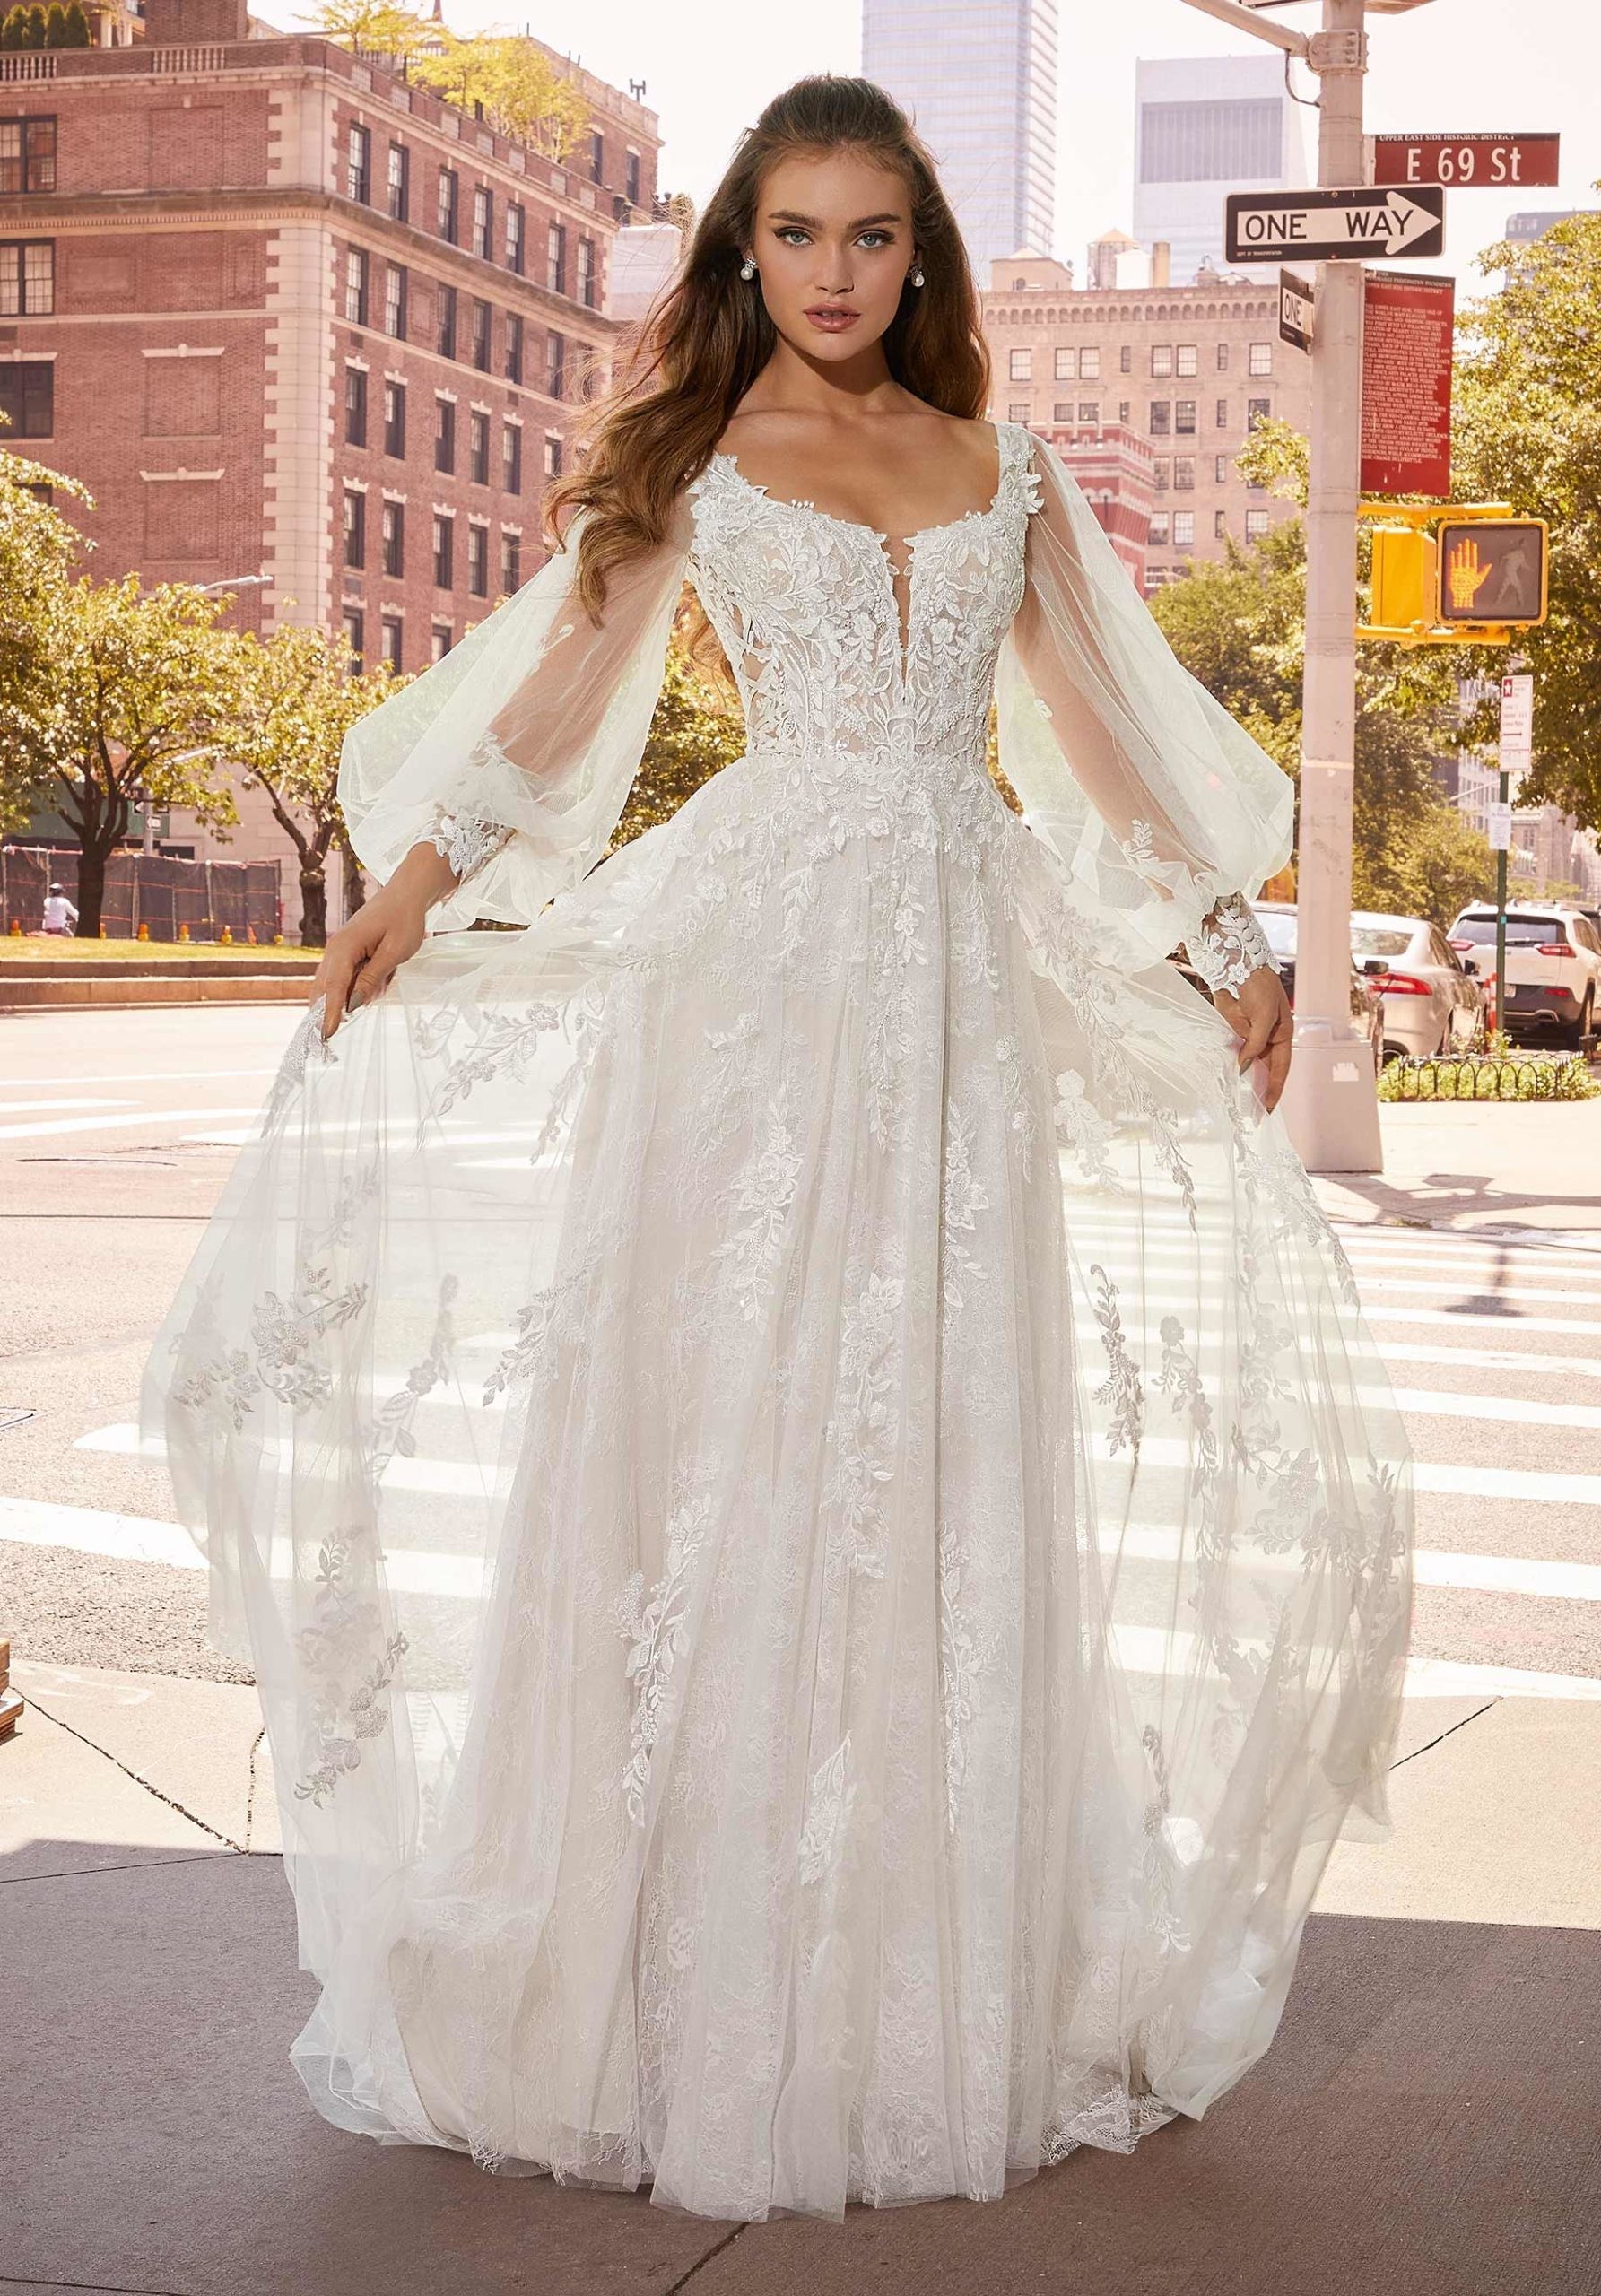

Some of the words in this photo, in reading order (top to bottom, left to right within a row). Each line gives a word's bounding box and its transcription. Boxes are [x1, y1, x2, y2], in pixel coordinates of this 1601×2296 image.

[1407, 148, 1421, 181] E
[1437, 147, 1475, 182] 69
[1490, 147, 1521, 182] St
[1245, 213, 1307, 241] ONE
[1345, 209, 1414, 238] WAY
[1284, 293, 1301, 327] ONE
